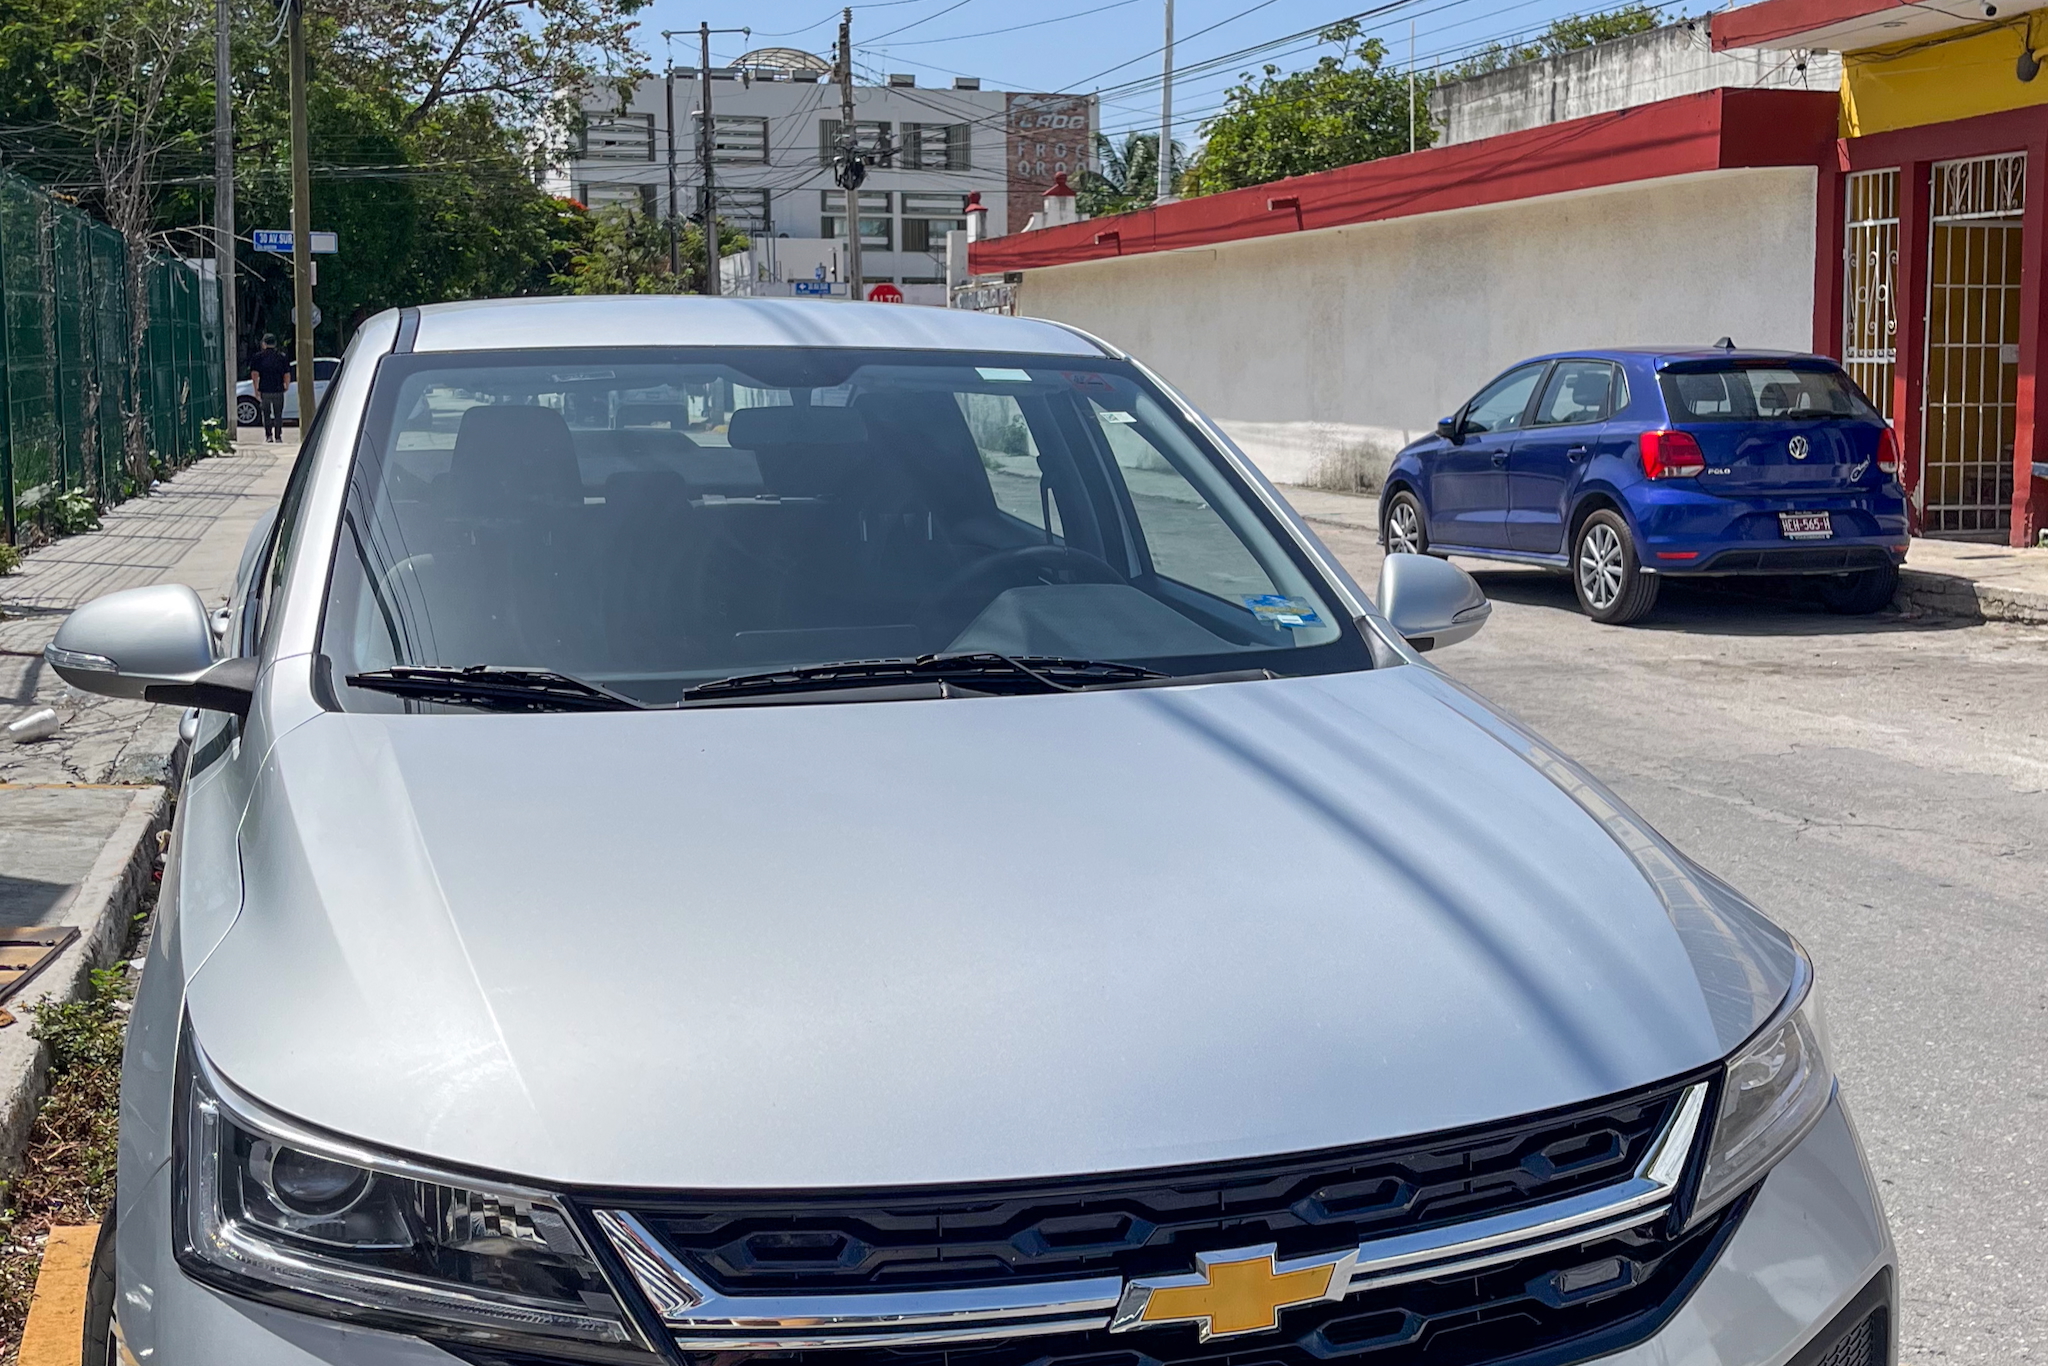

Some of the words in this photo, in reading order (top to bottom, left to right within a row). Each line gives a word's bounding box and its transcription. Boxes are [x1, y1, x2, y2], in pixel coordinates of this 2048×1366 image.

[259, 233, 268, 244] 30
[279, 233, 293, 245] SUR
[1707, 467, 1731, 475] POLO
